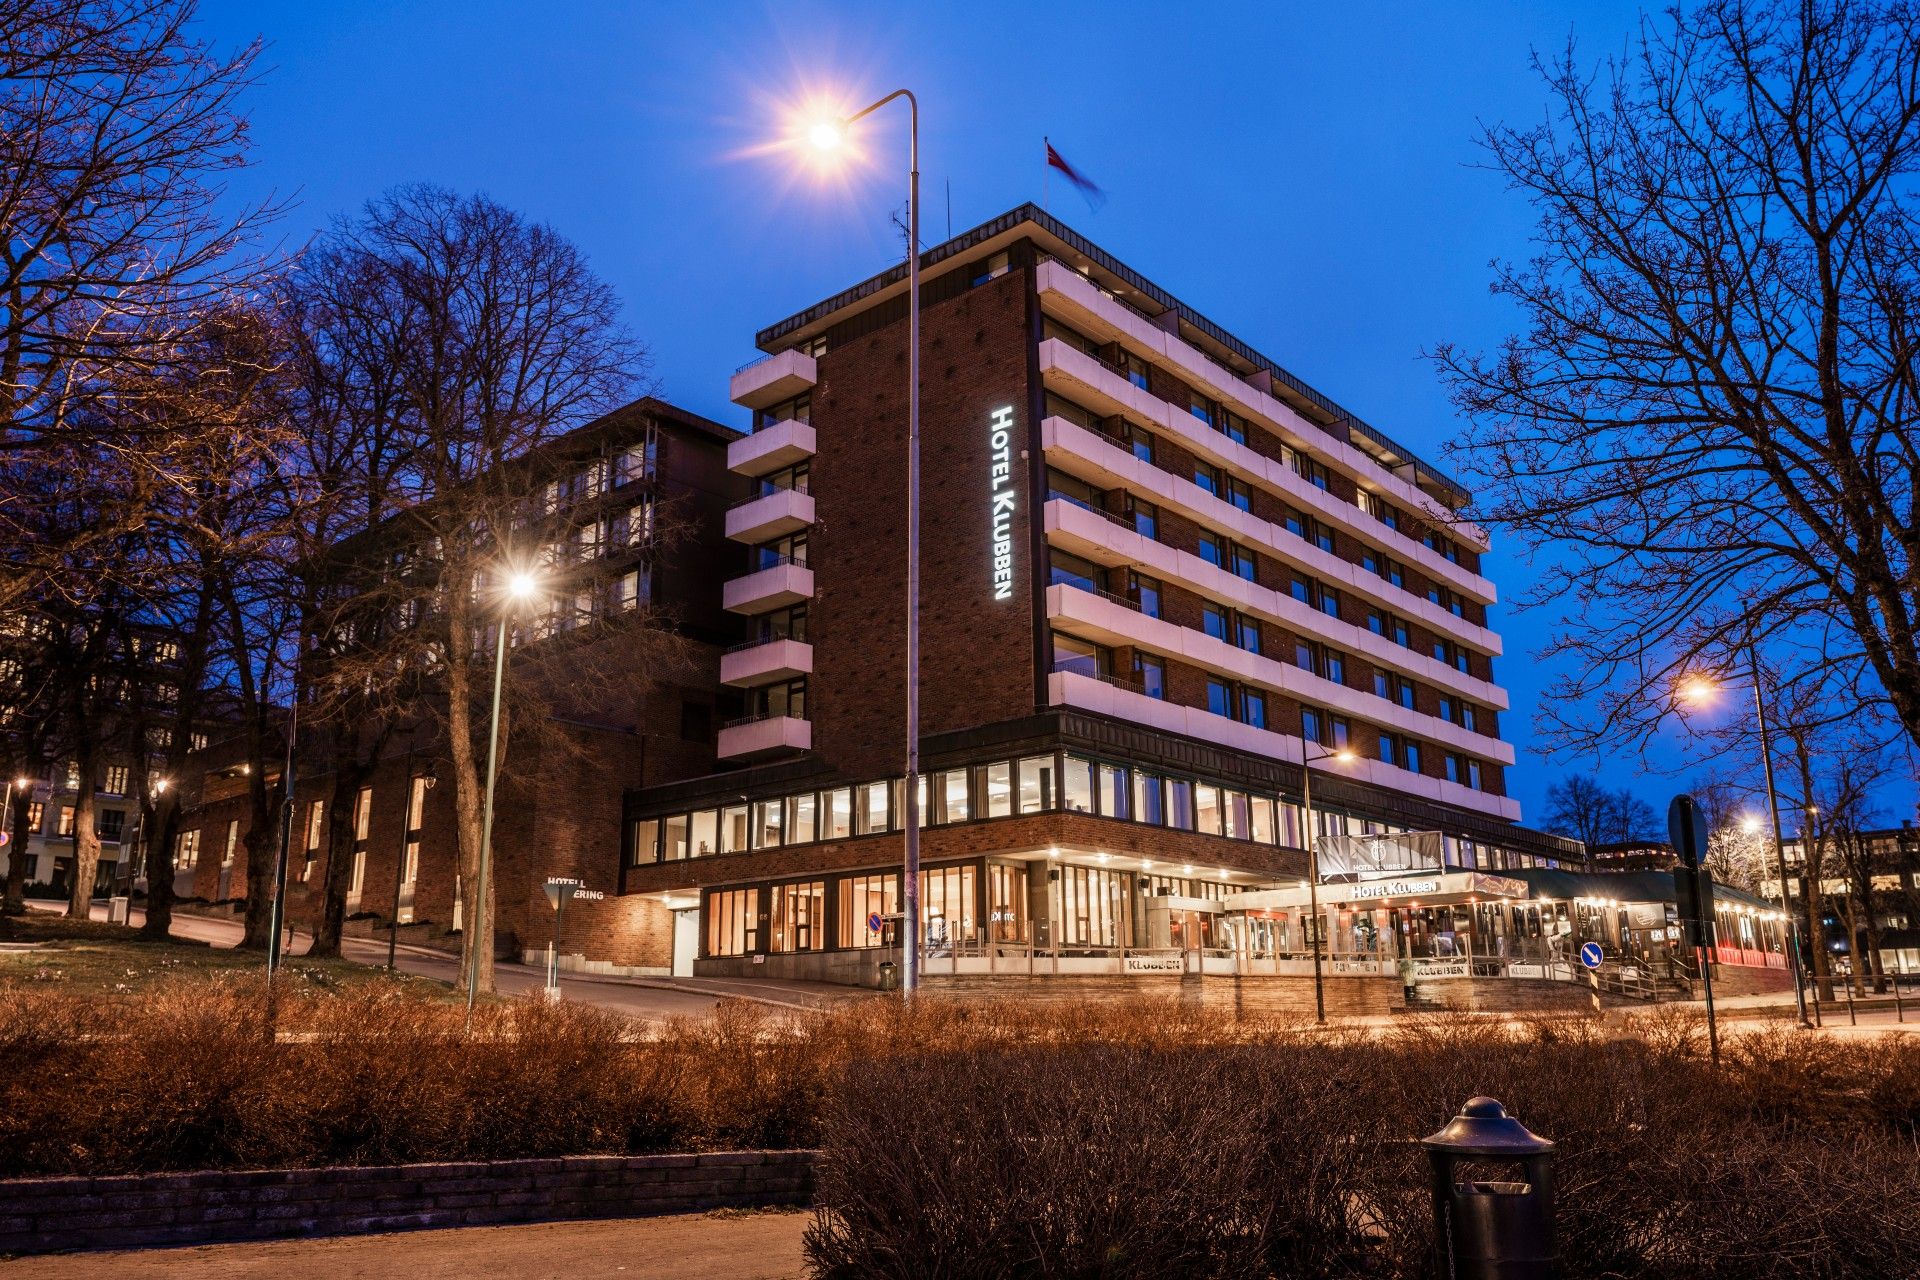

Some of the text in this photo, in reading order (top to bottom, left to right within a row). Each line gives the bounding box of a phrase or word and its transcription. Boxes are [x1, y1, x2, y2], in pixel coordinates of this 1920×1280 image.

[991, 405, 1015, 600] HOTEL KLUBBEN
[573, 889, 604, 900] ERING
[1351, 880, 1437, 899] HOTEL KLUBBEN
[1417, 964, 1464, 976] KLUBBEN
